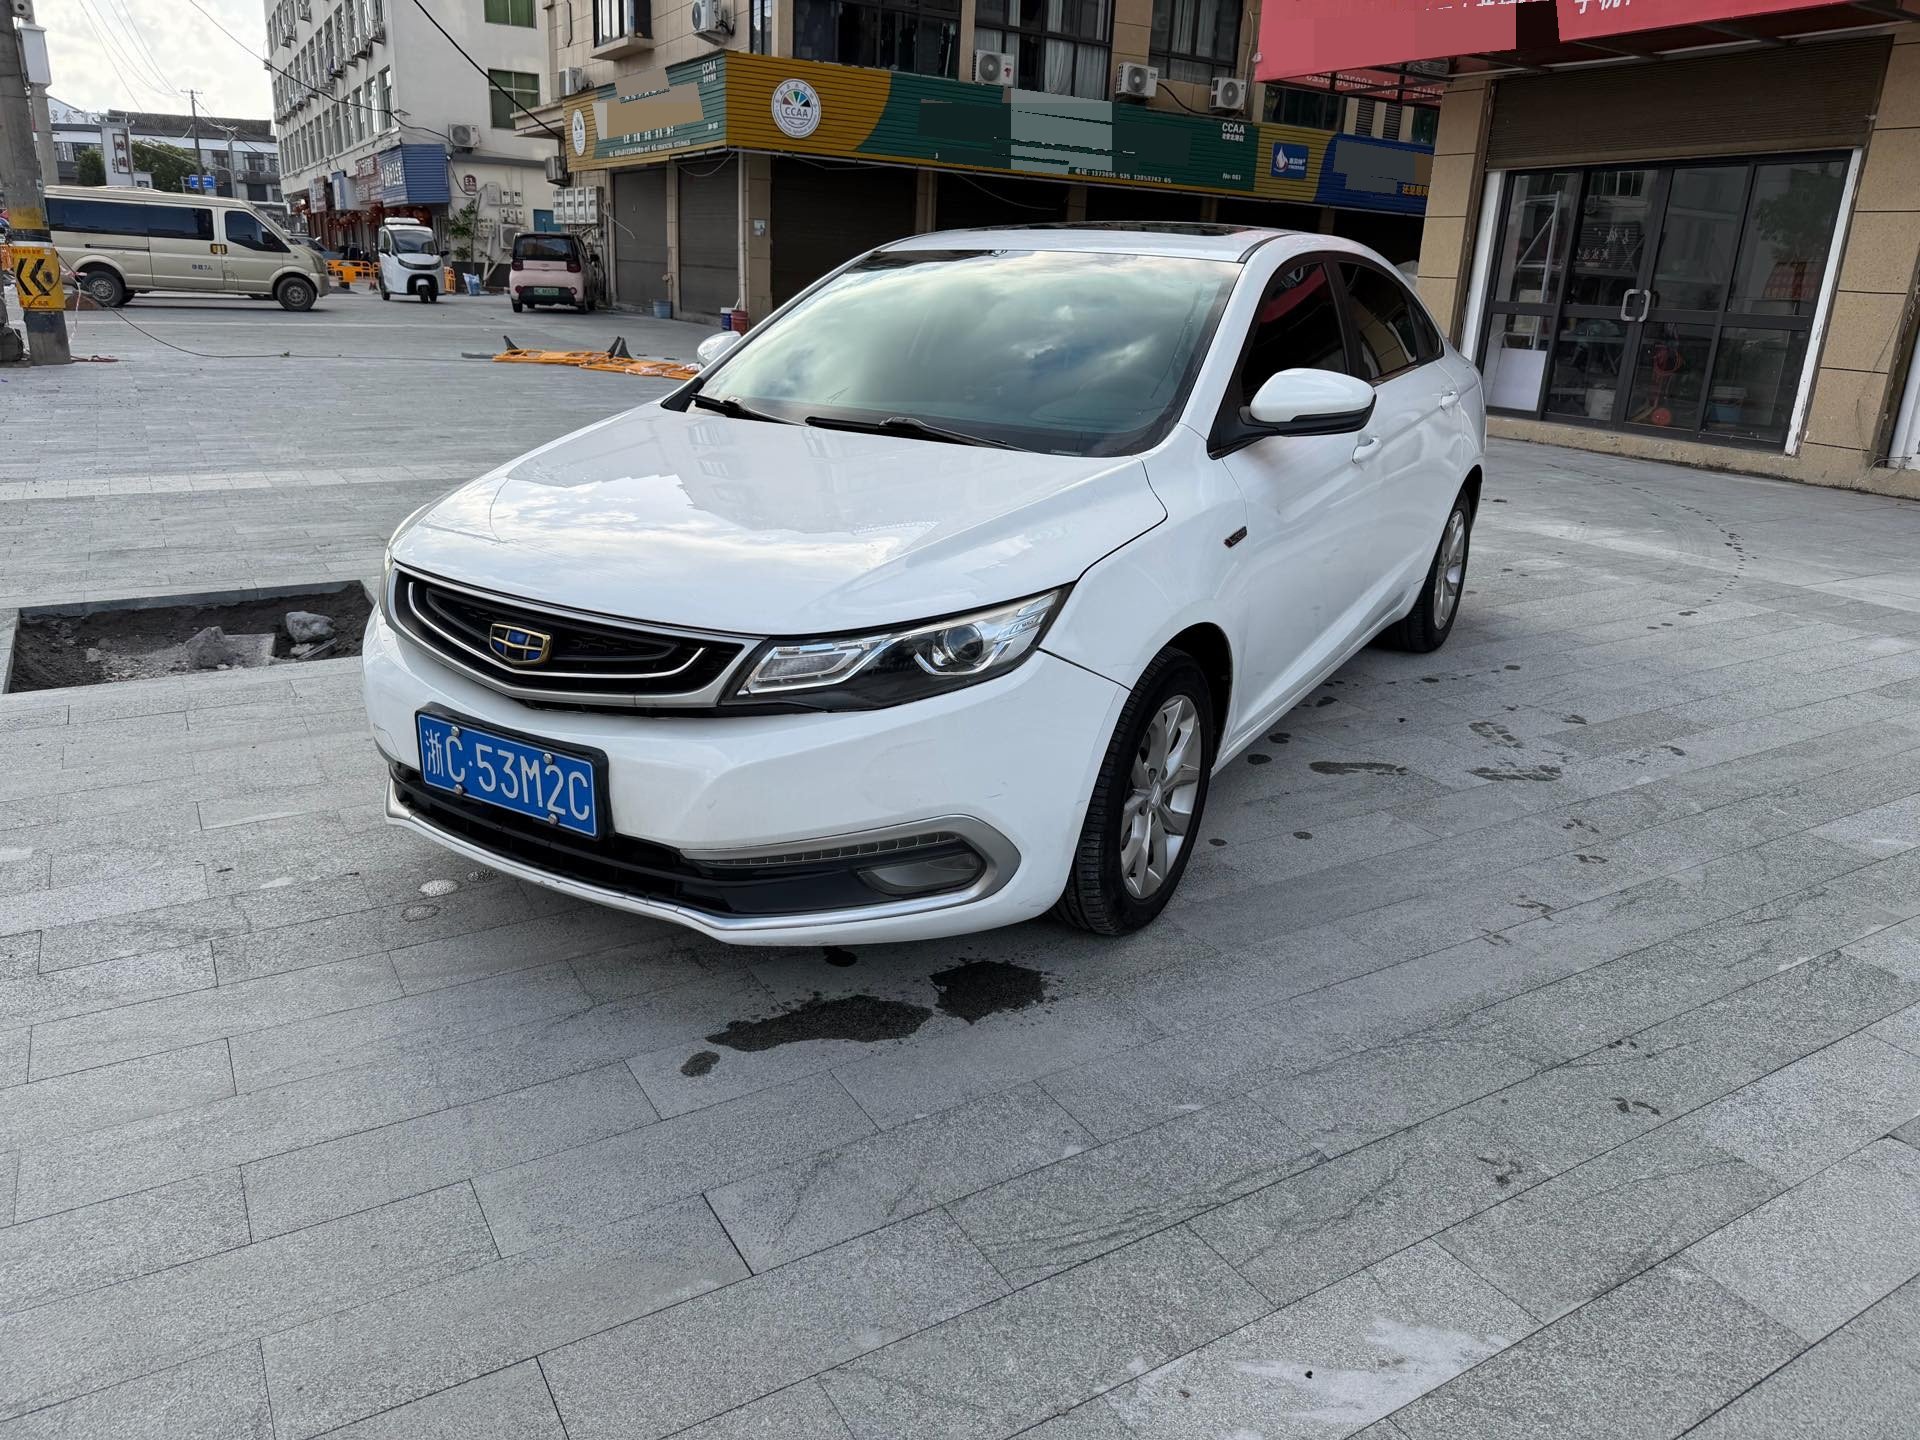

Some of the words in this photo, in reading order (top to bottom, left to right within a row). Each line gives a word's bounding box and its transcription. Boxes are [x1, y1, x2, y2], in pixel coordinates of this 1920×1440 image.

[702, 60, 717, 74] CCAA
[785, 107, 808, 118] CCAA
[1222, 122, 1245, 134] CCAA
[425, 729, 590, 821] 浙C·53M2C
